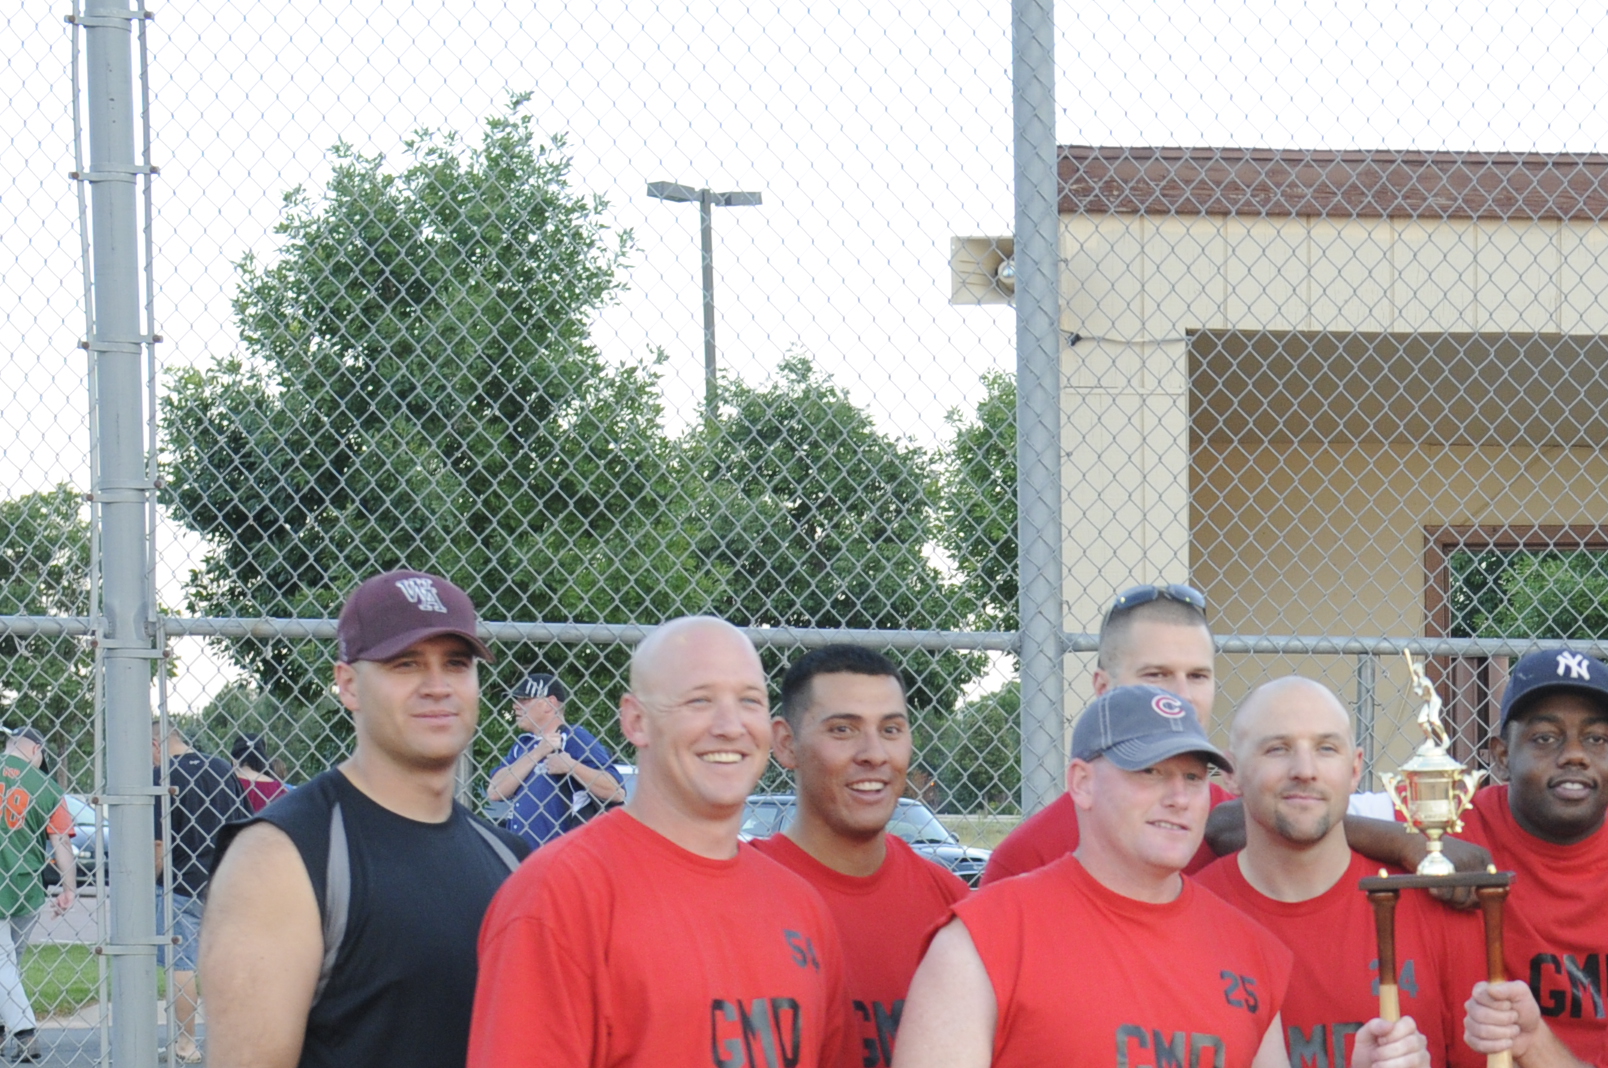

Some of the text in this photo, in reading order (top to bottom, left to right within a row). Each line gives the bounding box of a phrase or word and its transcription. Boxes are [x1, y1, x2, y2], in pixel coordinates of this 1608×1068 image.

[1556, 650, 1590, 681] NY
[1151, 694, 1186, 719] C
[1219, 969, 1259, 1014] 25
[852, 998, 906, 1068] GM
